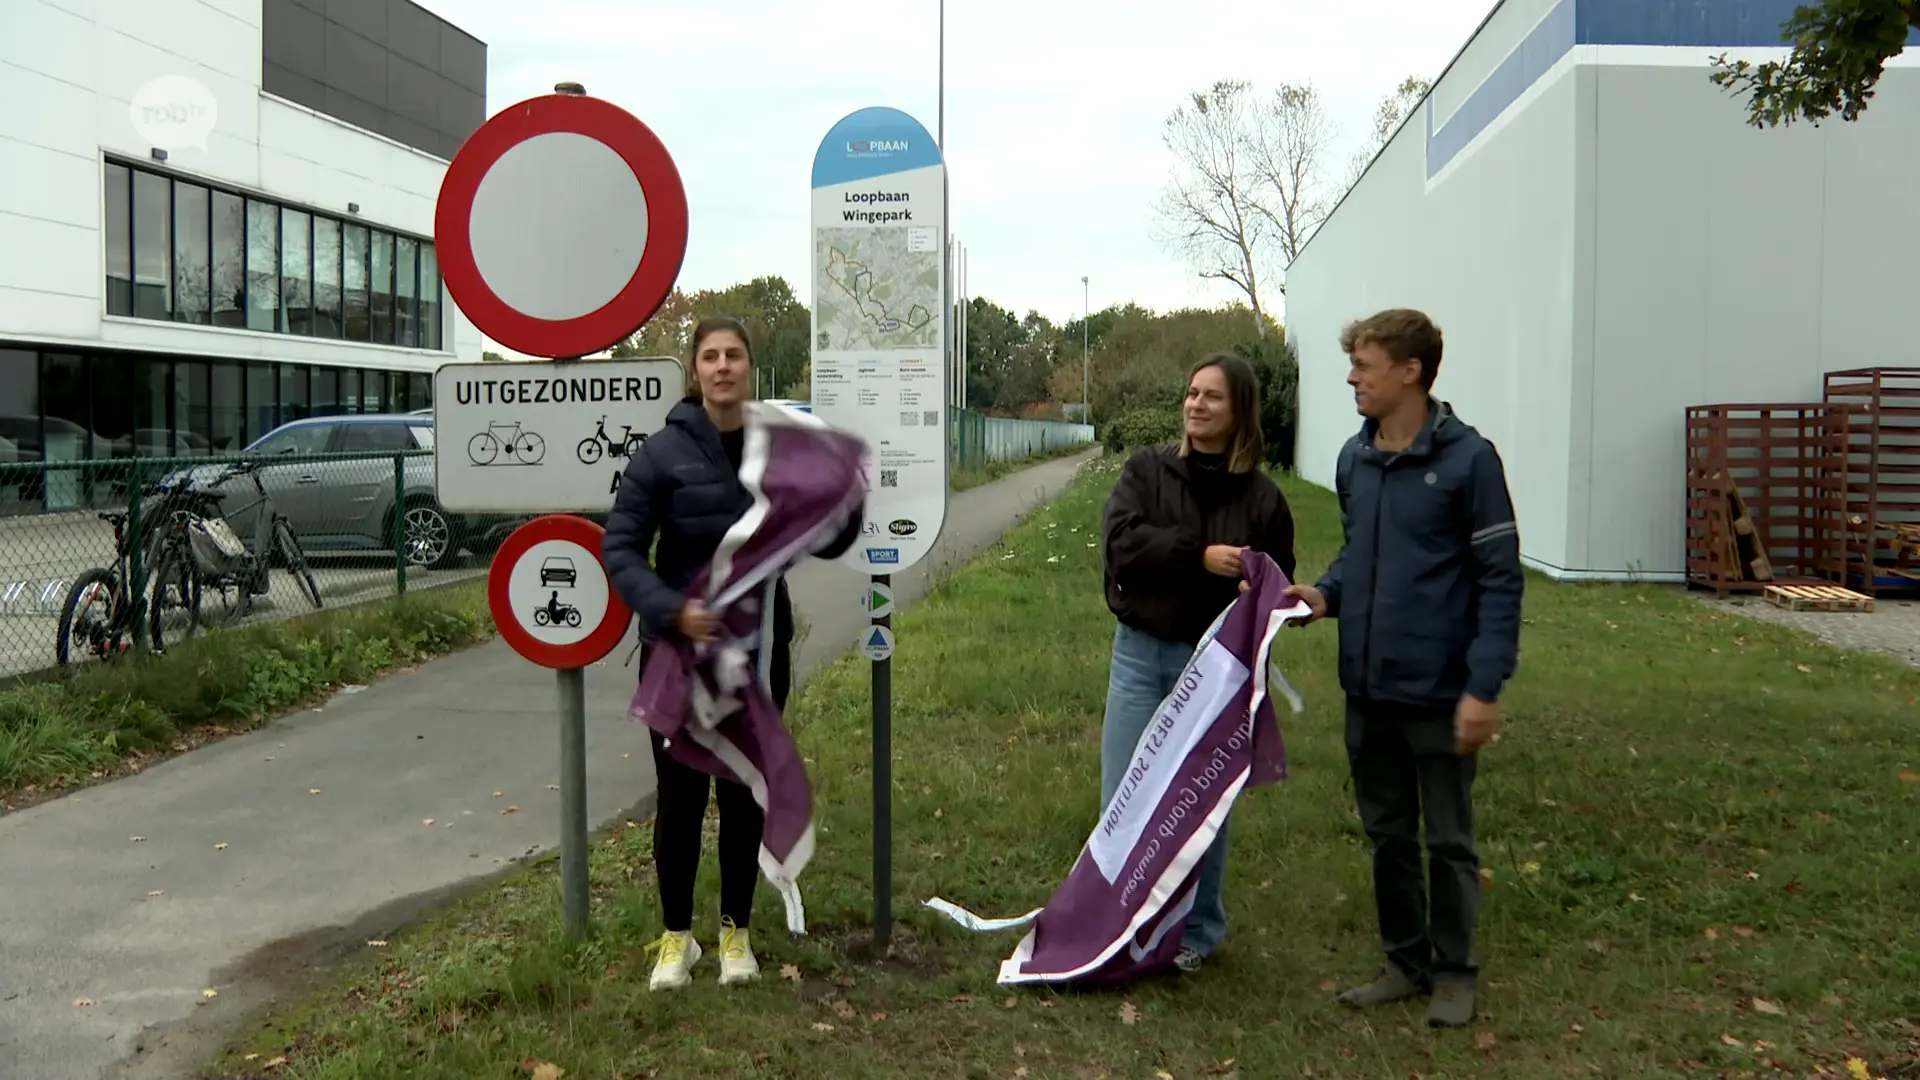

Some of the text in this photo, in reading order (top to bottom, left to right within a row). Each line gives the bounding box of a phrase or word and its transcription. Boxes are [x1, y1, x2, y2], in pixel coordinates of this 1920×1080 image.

[845, 190, 910, 205] Loopbaan
[842, 209, 912, 224] Wingepark
[456, 377, 662, 405] UITGEZONDERD
